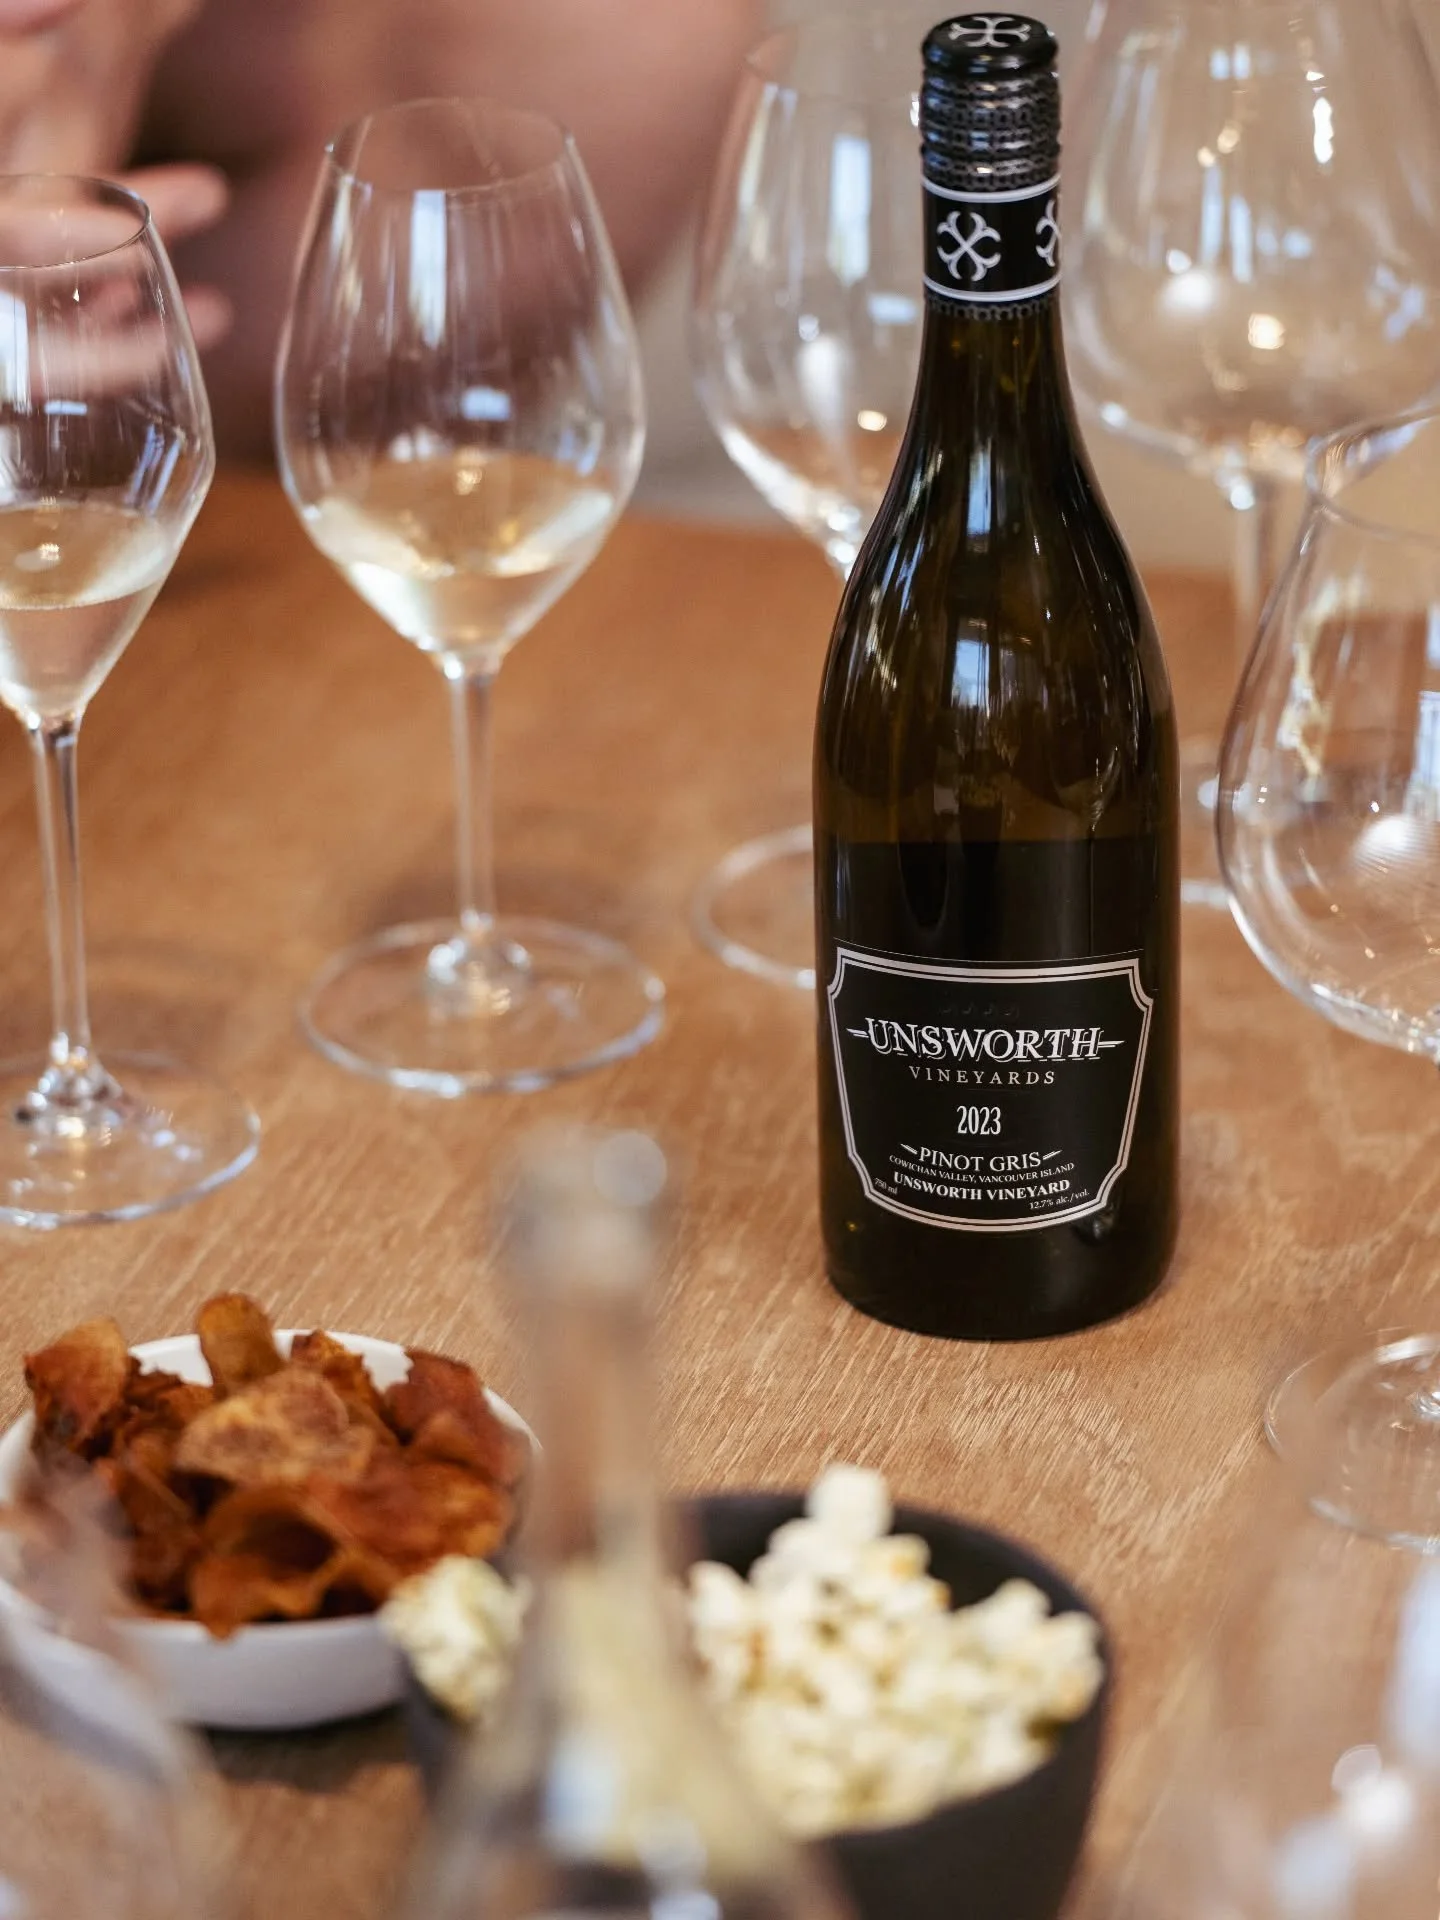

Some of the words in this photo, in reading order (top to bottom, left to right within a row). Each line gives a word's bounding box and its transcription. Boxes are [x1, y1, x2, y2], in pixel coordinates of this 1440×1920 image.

[865, 1017, 1104, 1062] UNSWORTH
[909, 1065, 1055, 1085] VINEYARDS
[956, 1105, 1001, 1135] 2023
[889, 1154, 937, 1176] COWICHAN
[939, 1170, 977, 1184] VALLEY,
[979, 1171, 1038, 1183] VANCOUVER
[1040, 1162, 1075, 1178] ISLAND
[919, 1146, 984, 1171] PINOT
[990, 1151, 1042, 1172] GRIS
[893, 1171, 982, 1200] UNSWORTH
[986, 1178, 1071, 1200] VINEYARD
